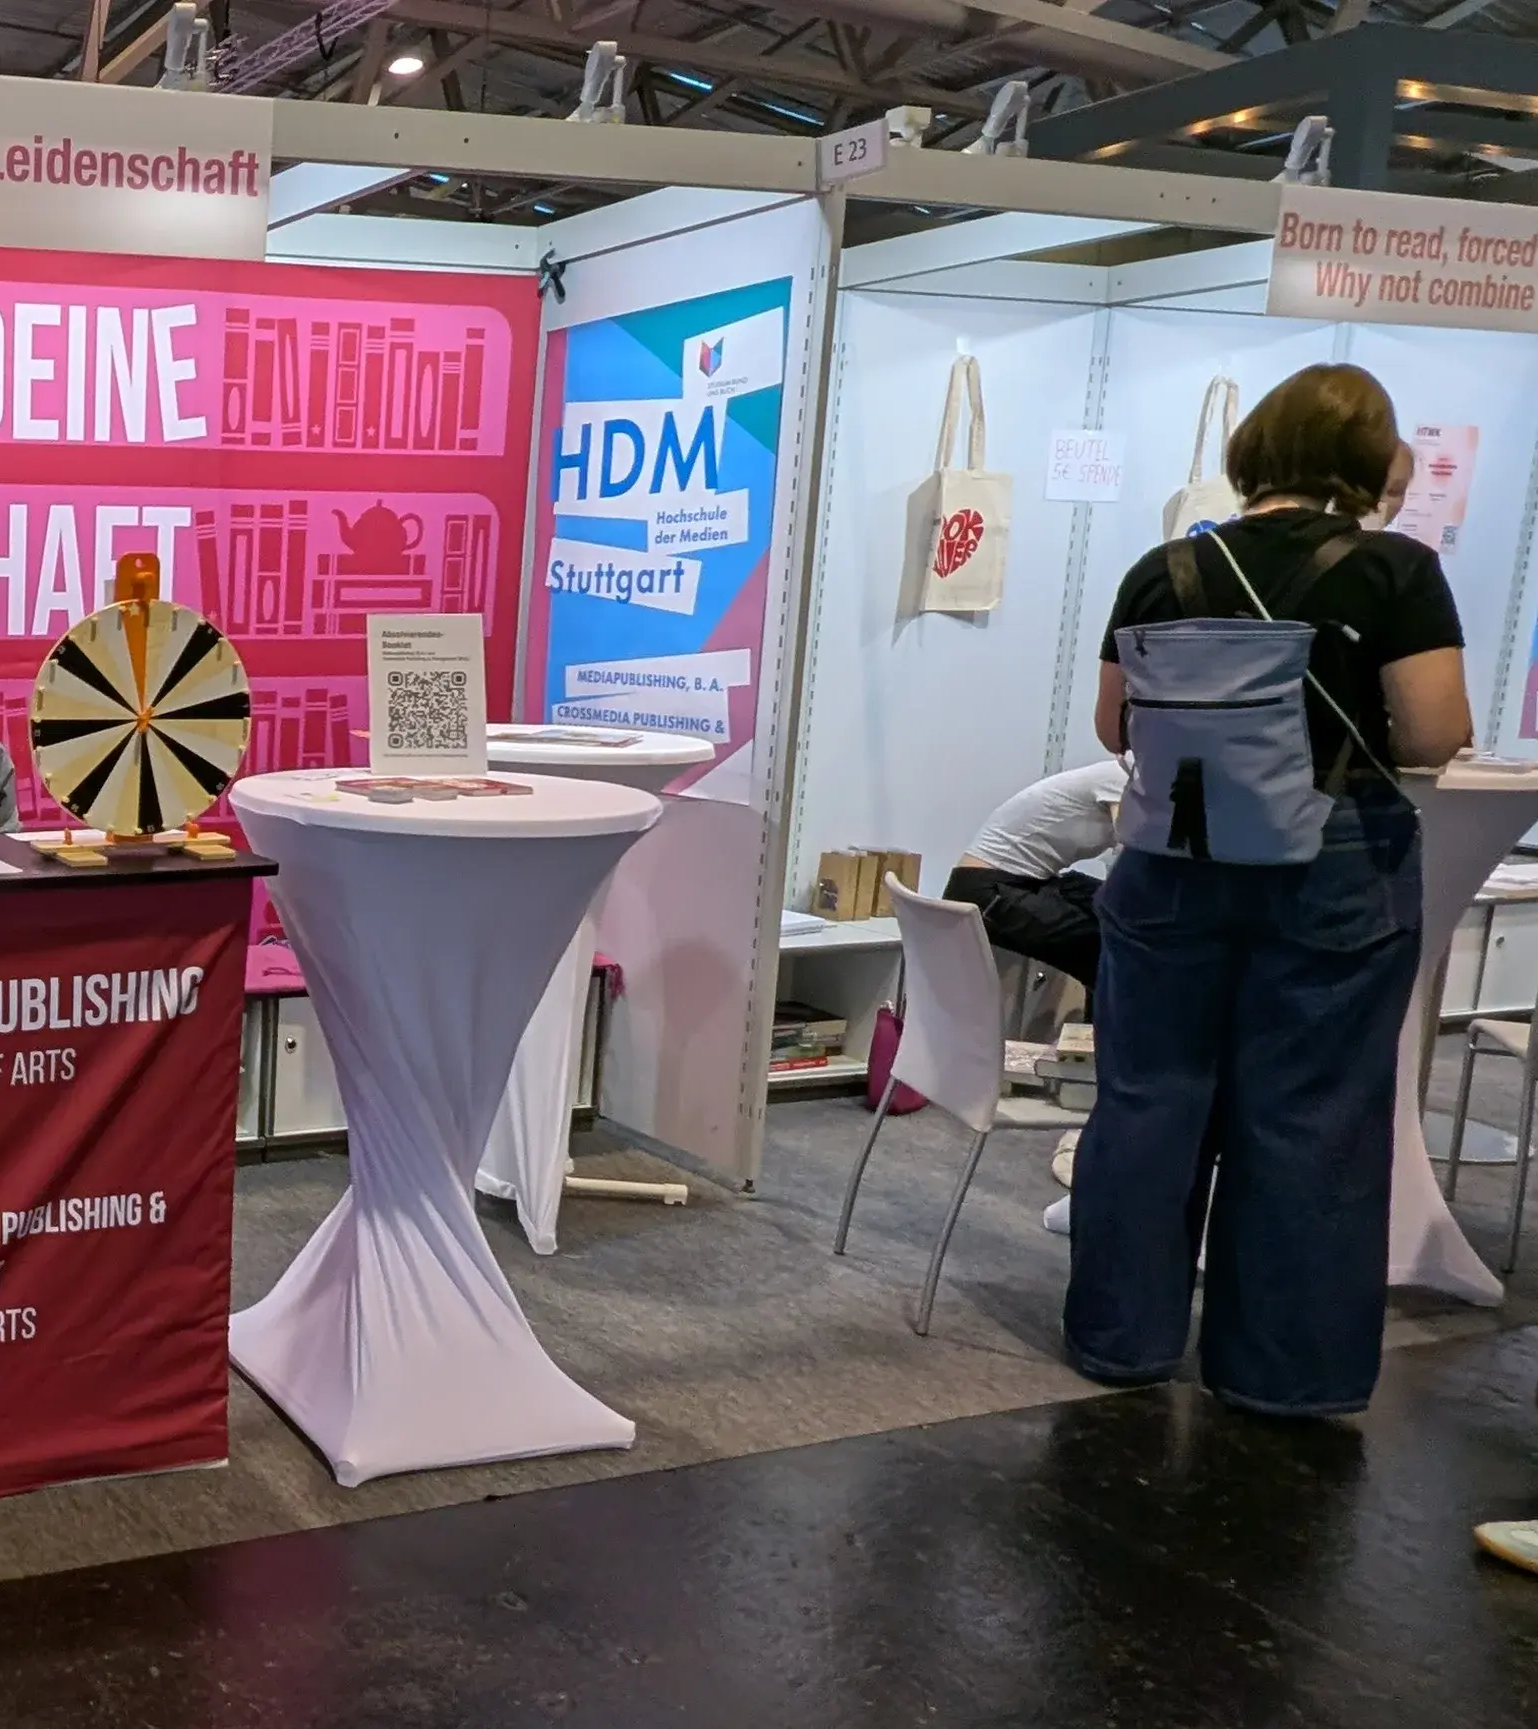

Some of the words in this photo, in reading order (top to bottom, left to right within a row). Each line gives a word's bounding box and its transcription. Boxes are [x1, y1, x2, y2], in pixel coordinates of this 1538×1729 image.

[834, 143, 844, 166] E
[849, 138, 867, 162] 23
[1279, 212, 1344, 251] Born
[1352, 217, 1378, 255] to
[1385, 225, 1449, 267] read,
[1457, 226, 1538, 268] forced
[1316, 260, 1373, 308] Why
[1378, 269, 1423, 304] not
[1428, 273, 1536, 312] combine
[550, 404, 719, 501] HDM
[1055, 438, 1110, 462] BEUTEL
[656, 505, 728, 526] Hochschule
[654, 530, 676, 545] der
[679, 527, 729, 543] Medien
[549, 560, 685, 604] Stuttgart
[577, 670, 691, 692] MEDIAPUBLISHING,
[557, 705, 631, 725] CROSSMEDIA
[633, 708, 711, 731] PUBLISHING
[714, 719, 725, 733] &
[10, 1047, 77, 1086] ARTS
[2, 1192, 143, 1246] PUBLISHING
[149, 1191, 167, 1225] &
